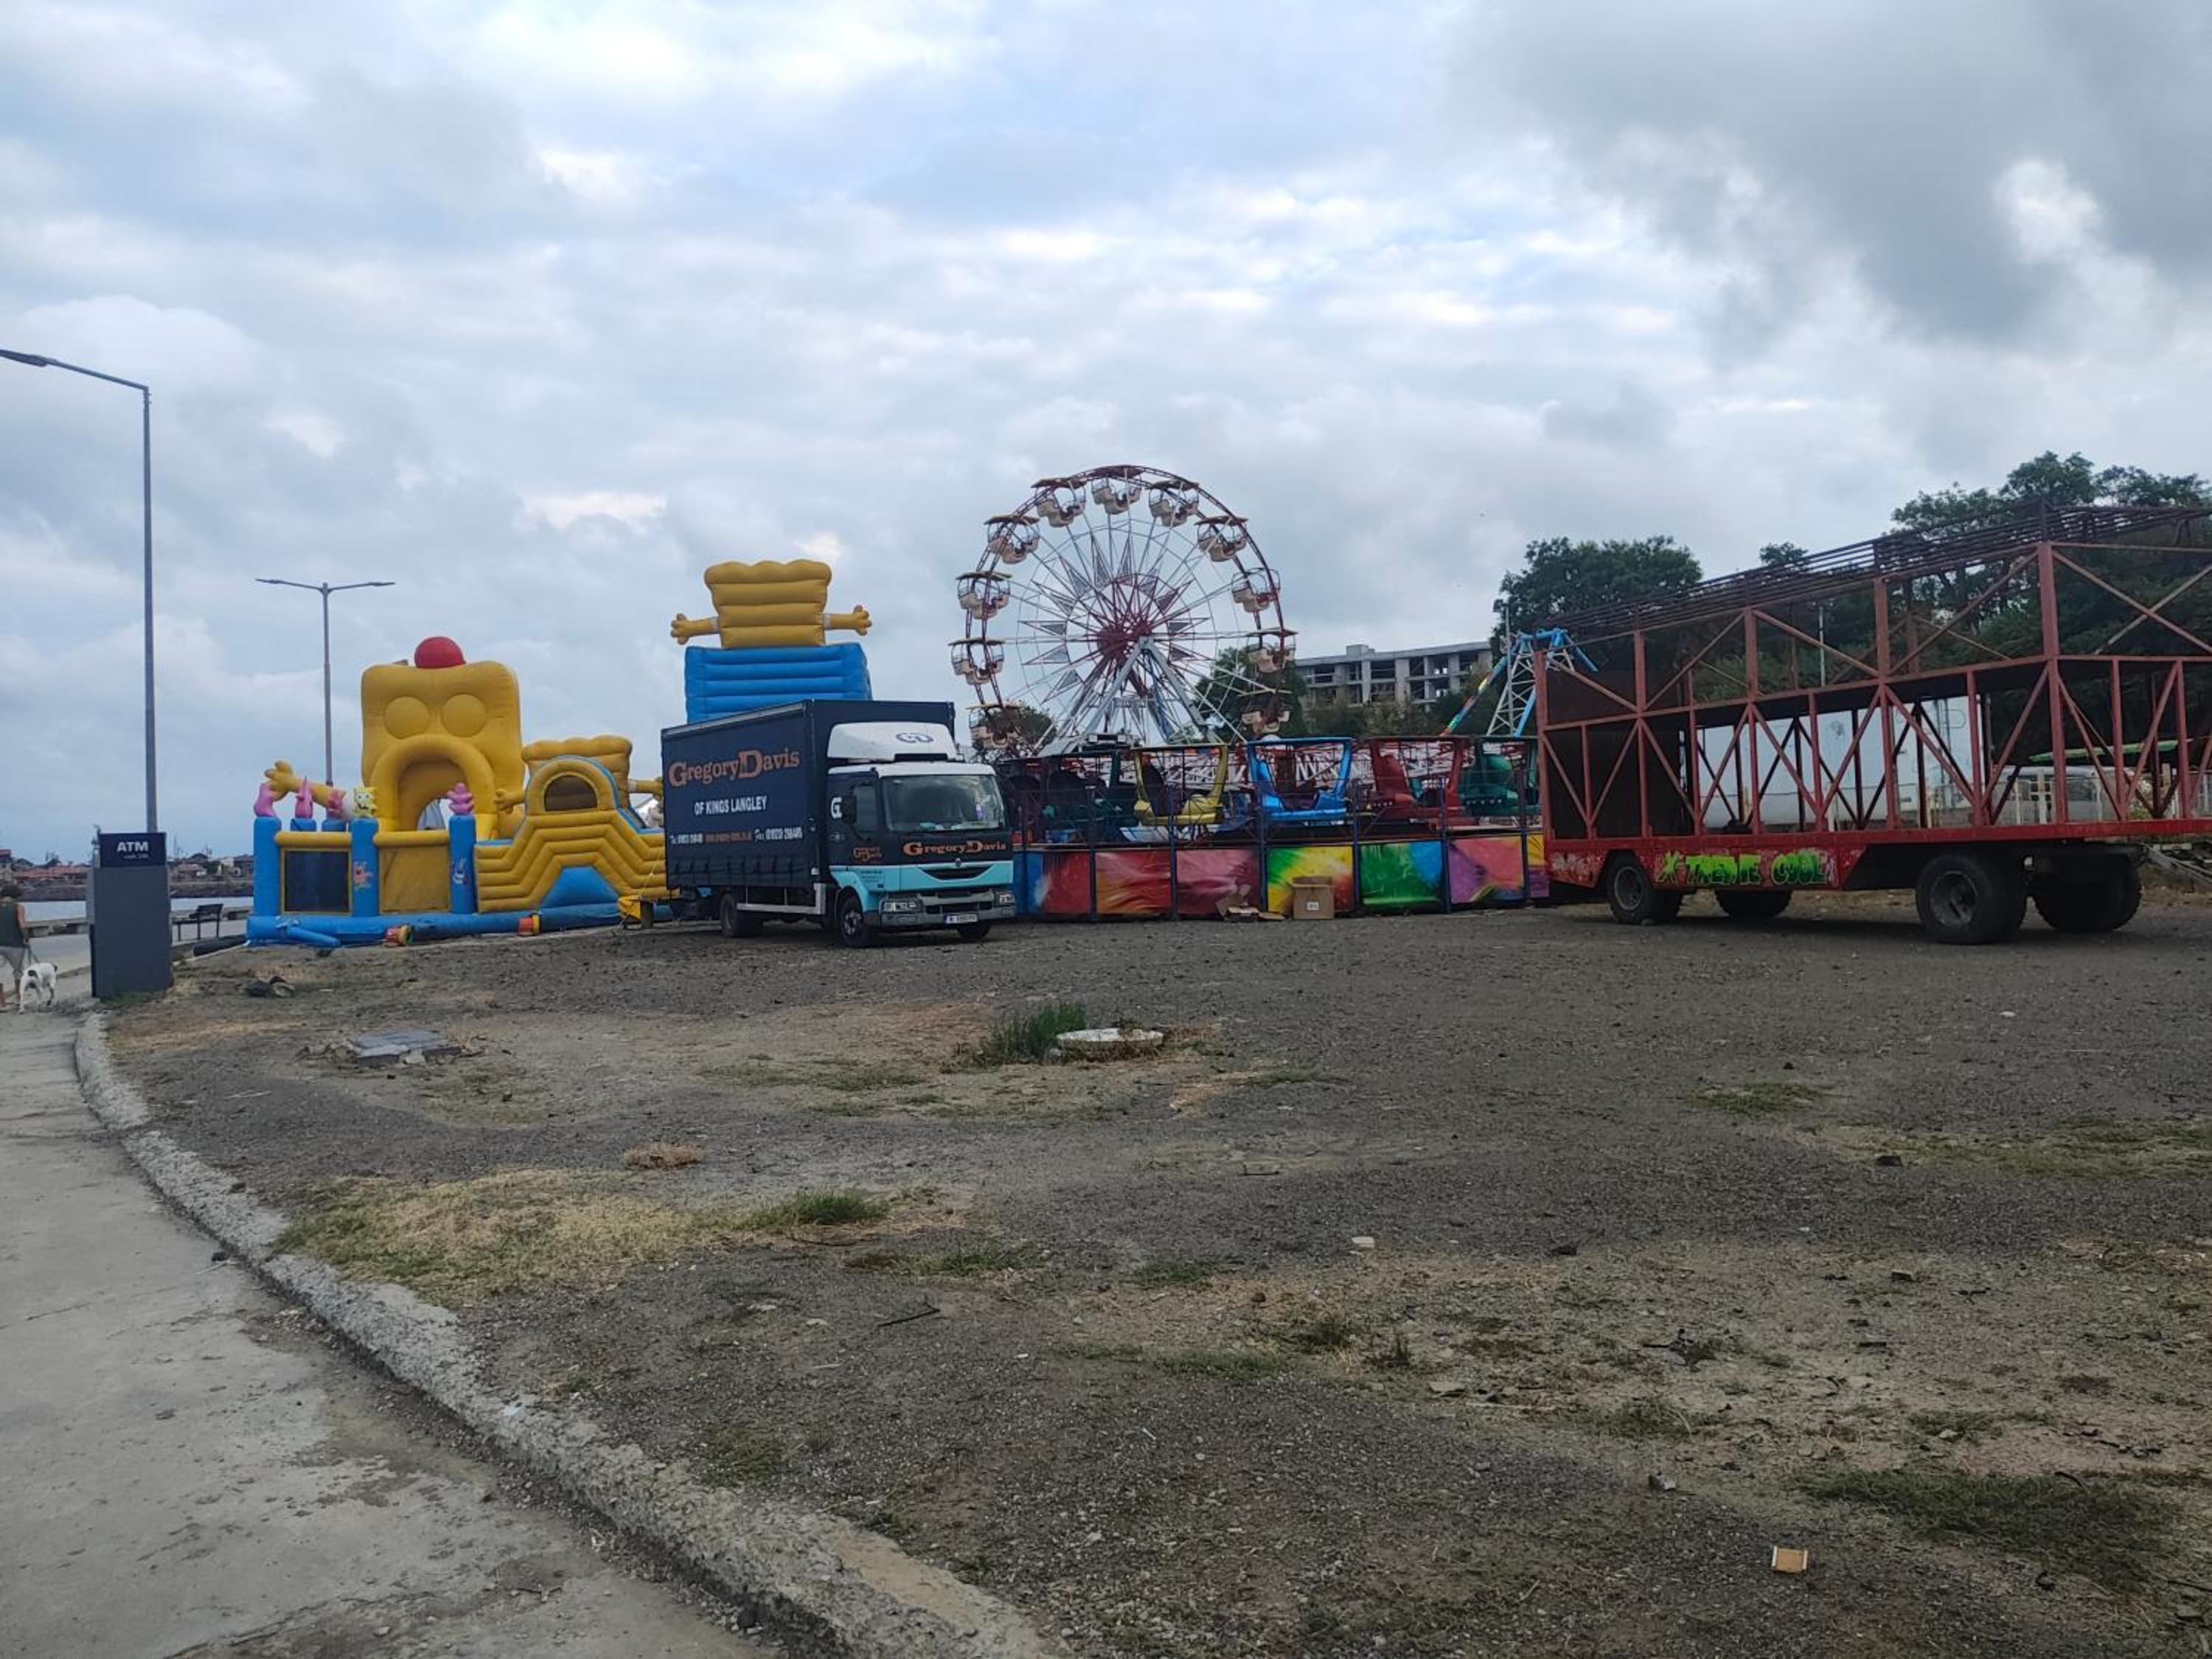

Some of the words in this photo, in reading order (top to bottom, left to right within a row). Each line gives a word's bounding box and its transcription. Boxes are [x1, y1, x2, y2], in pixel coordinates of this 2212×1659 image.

[695, 801, 704, 815] OF
[706, 799, 729, 815] KINGS
[731, 796, 768, 813] LANGLEY
[116, 841, 149, 852] ATM
